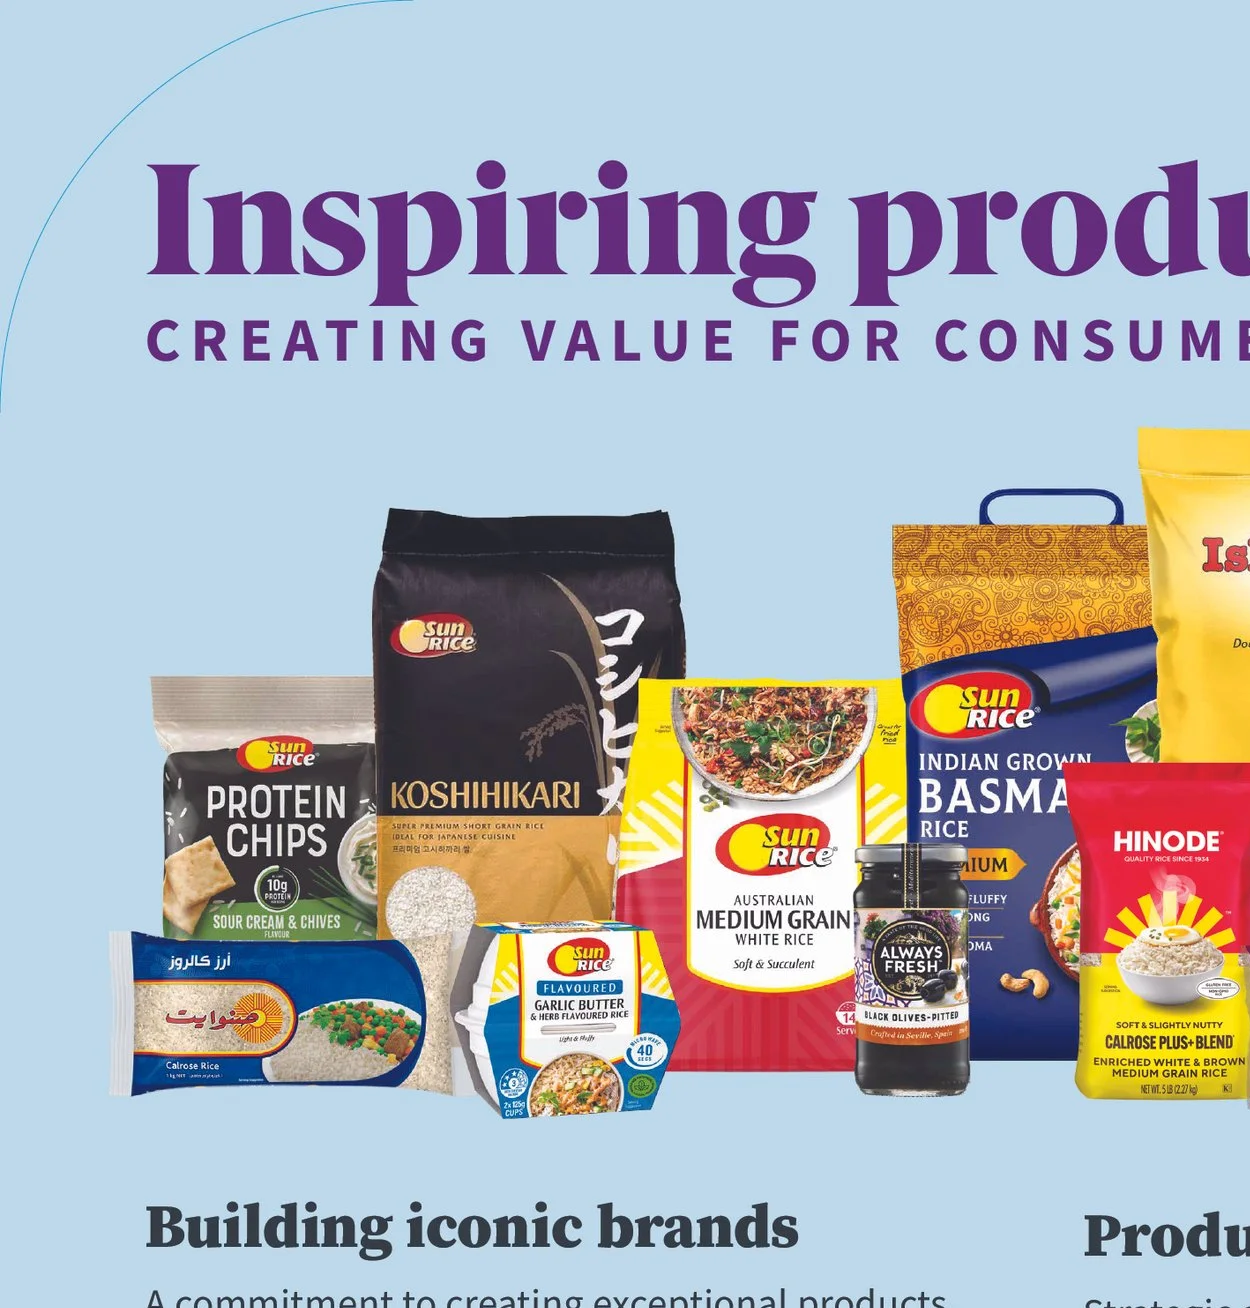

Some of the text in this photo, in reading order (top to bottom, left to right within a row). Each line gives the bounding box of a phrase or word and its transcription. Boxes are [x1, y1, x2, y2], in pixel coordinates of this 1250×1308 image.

[147, 160, 817, 308] Inspiring
[147, 319, 485, 362] CREATING
[521, 320, 732, 362] VALUE
[773, 319, 899, 362] FOR
[920, 753, 998, 771] INDIAN
[208, 785, 345, 818] PROTEIN
[391, 781, 580, 808] KOSHIHIKARI
[921, 821, 968, 837] RICE
[227, 823, 327, 857] CHIPS
[1114, 831, 1220, 852] HINODE
[734, 895, 814, 906] AUSTRALIAN
[213, 915, 340, 929] SOUR CREAM & CHIVES
[697, 910, 850, 929] MEDIUM GRAIN
[736, 934, 813, 945] WHITE RICE
[881, 946, 943, 959] ALWAYS
[733, 958, 815, 970] Soft & Succulent
[885, 961, 938, 973] FRESH
[544, 983, 616, 994] FLAVOURED
[535, 999, 624, 1011] GARLIC BUTTER
[865, 1011, 889, 1021] BLACK
[1106, 1035, 1156, 1049] CALROSE
[166, 1062, 220, 1070] Calrose Rice
[146, 1201, 798, 1261] Building iconic brands
